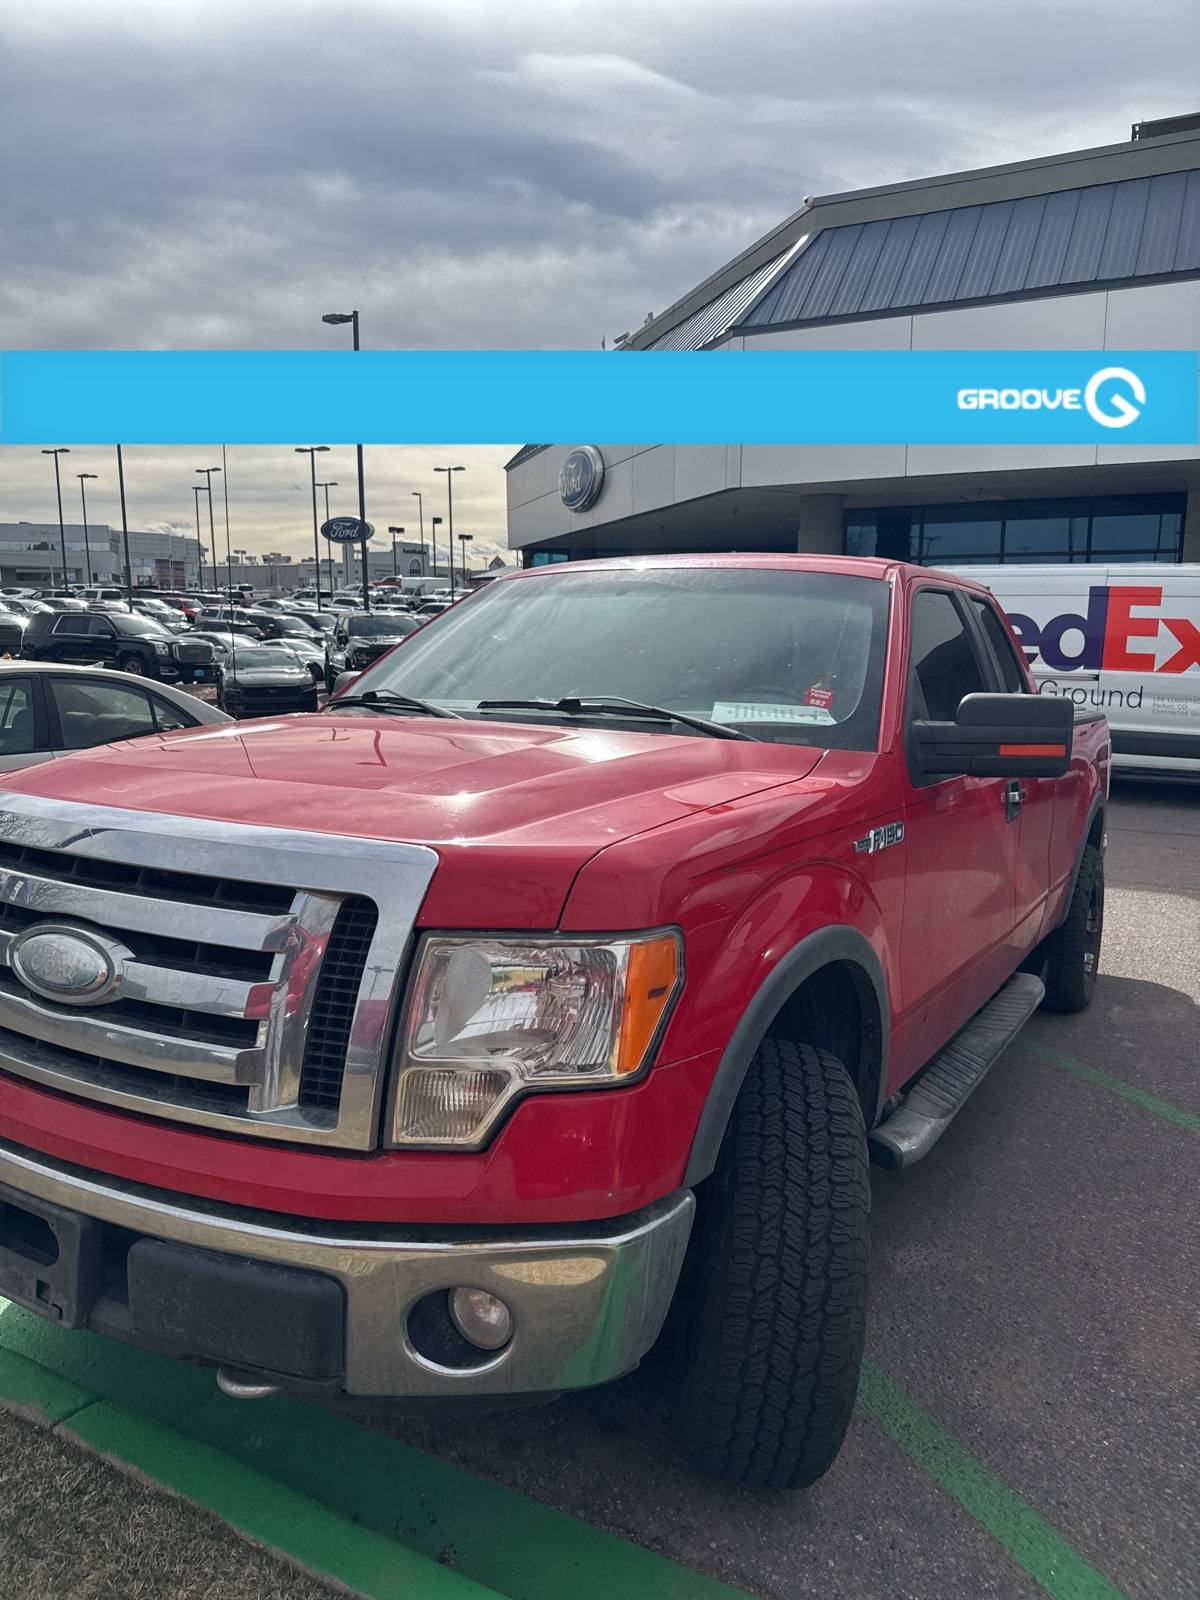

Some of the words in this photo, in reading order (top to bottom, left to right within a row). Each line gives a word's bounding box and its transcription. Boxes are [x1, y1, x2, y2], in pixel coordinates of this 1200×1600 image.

[330, 521, 360, 538] Ford
[1004, 586, 1200, 674] edEx
[1039, 679, 1144, 709] Ground
